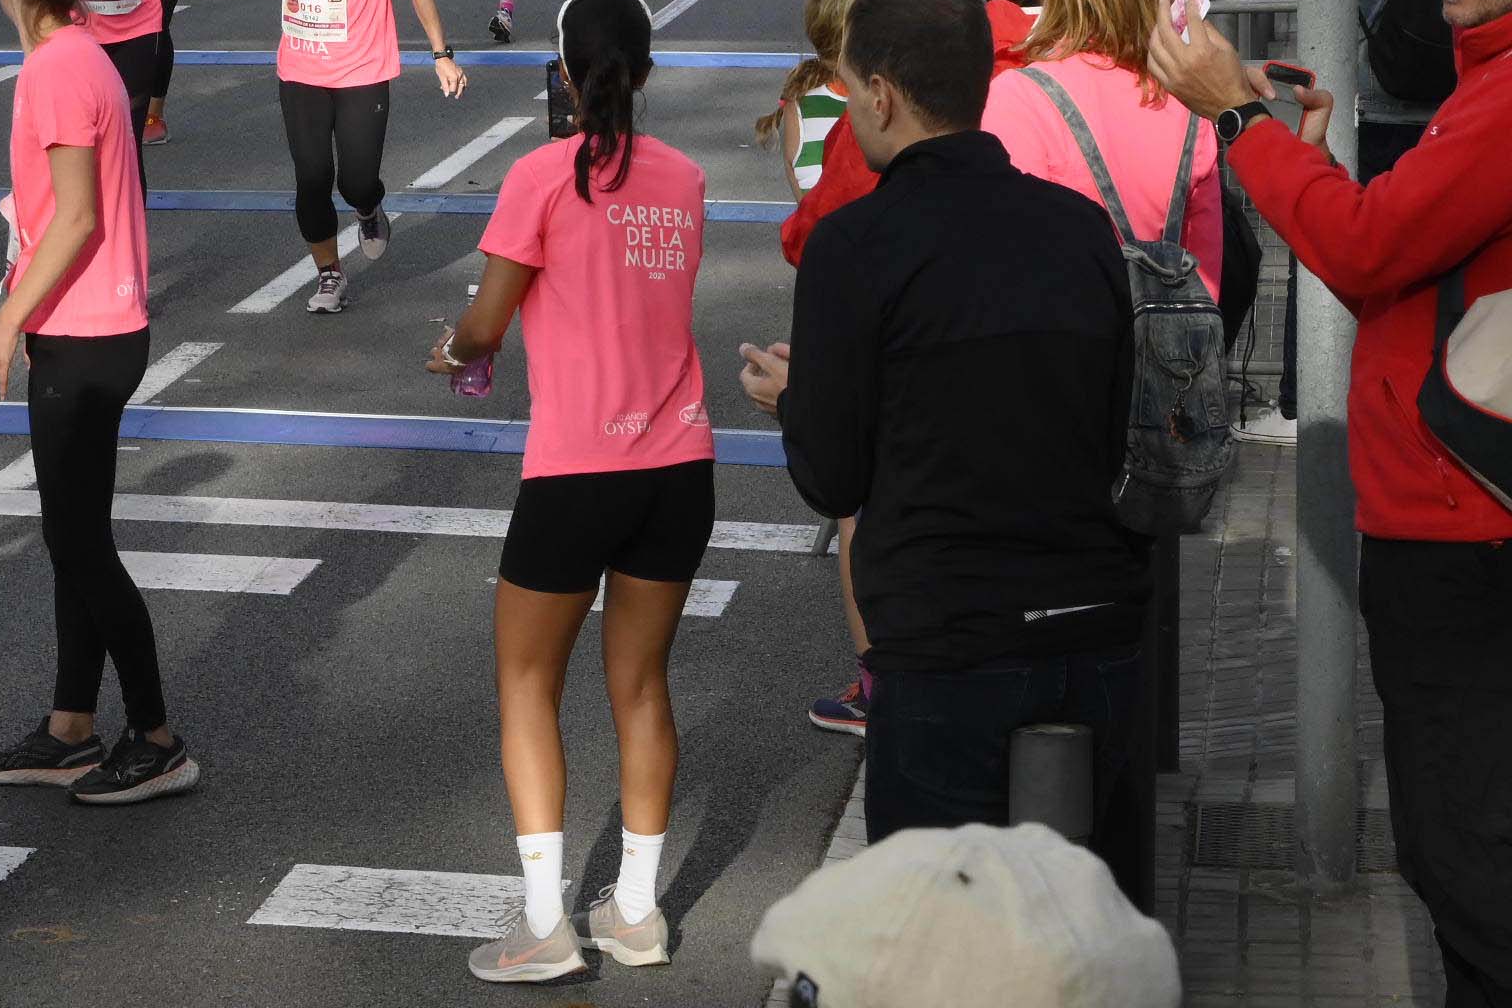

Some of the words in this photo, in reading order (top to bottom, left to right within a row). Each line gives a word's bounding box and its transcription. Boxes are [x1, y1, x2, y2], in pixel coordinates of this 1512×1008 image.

[300, 2, 323, 14] 016
[290, 36, 329, 55] UMA
[606, 203, 695, 231] CARRERA
[626, 226, 652, 247] DE
[659, 228, 684, 250] LA
[624, 246, 686, 272] MUJER
[648, 271, 667, 281] 2023
[604, 420, 651, 435] OYSH
